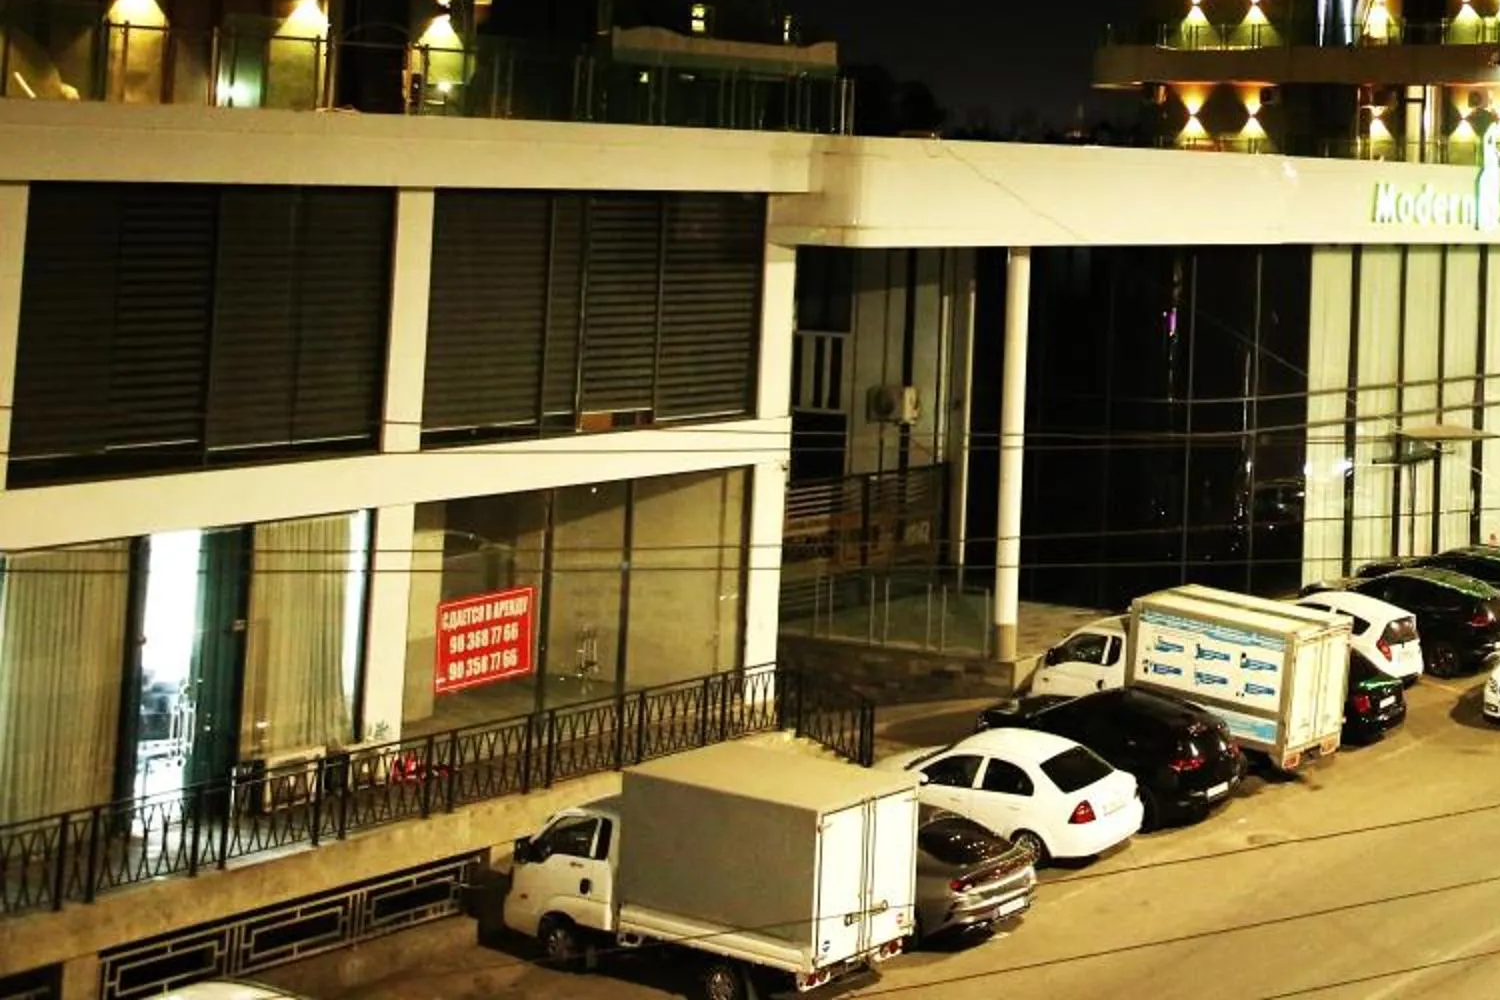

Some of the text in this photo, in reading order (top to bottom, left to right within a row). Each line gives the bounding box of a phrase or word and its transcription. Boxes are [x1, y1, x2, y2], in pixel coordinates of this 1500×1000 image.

[1370, 183, 1475, 226] Modern
[490, 625, 503, 645] 77
[489, 650, 502, 671] 77
